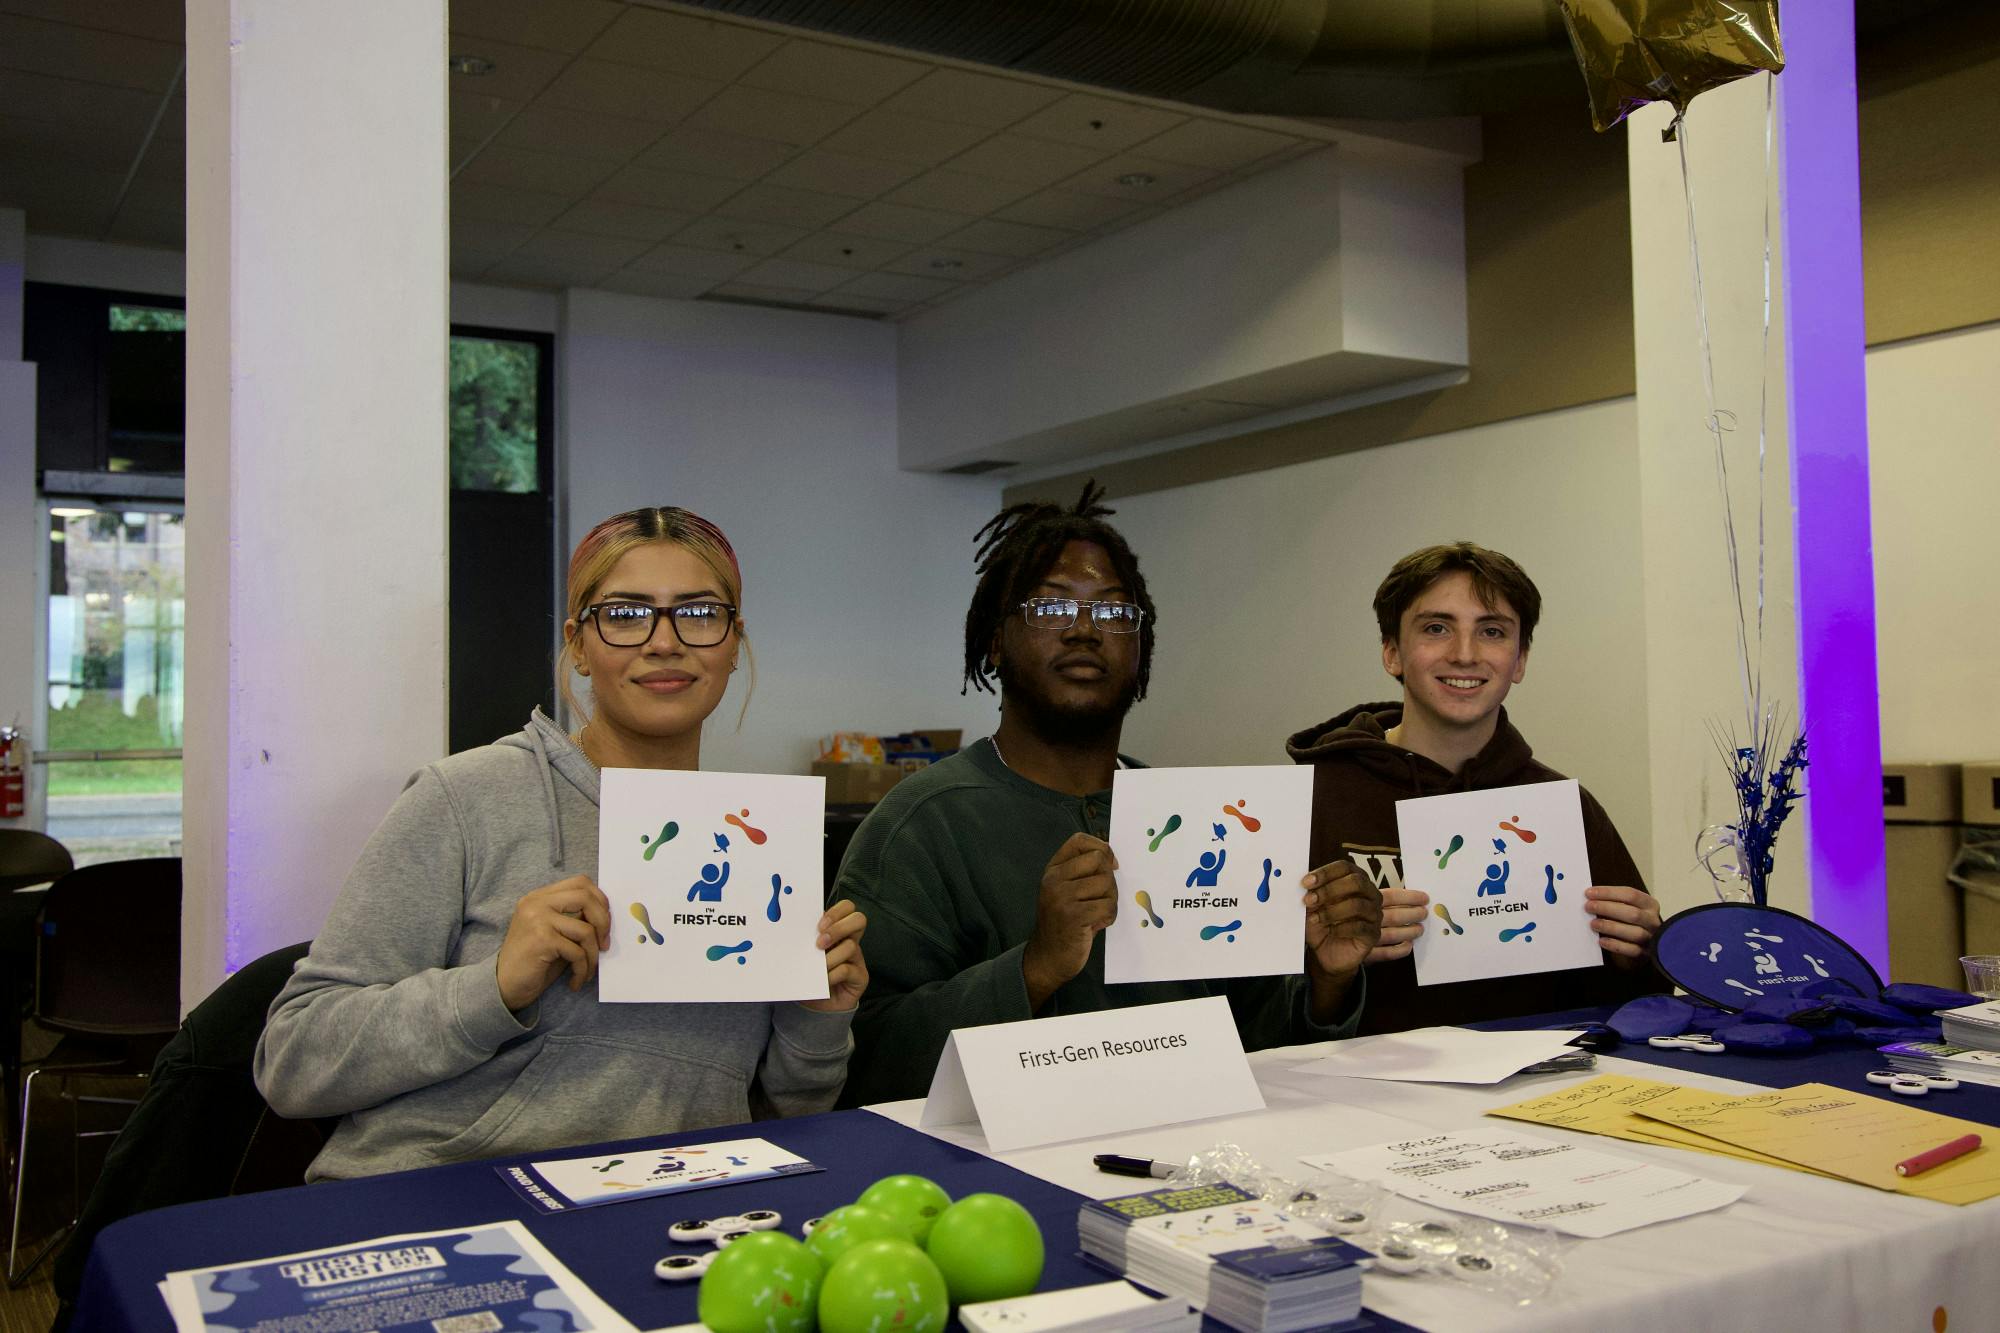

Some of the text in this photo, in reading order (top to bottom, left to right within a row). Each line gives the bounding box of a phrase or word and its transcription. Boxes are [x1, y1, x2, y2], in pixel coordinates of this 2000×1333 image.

[1172, 897, 1238, 909] FIRST-GEN
[1468, 902, 1529, 917] FIRST-GEN
[673, 914, 747, 926] FIRST-GEN
[1757, 975, 1810, 985] FIRST-GEN
[1018, 1033, 1188, 1069] First-Gen Resources
[507, 1167, 534, 1186] PROUD
[282, 1247, 425, 1276] FIRST YEAR
[300, 1262, 384, 1285] FIRST
[390, 1254, 432, 1266] GEN
[311, 1275, 422, 1298] NOVEMBER
